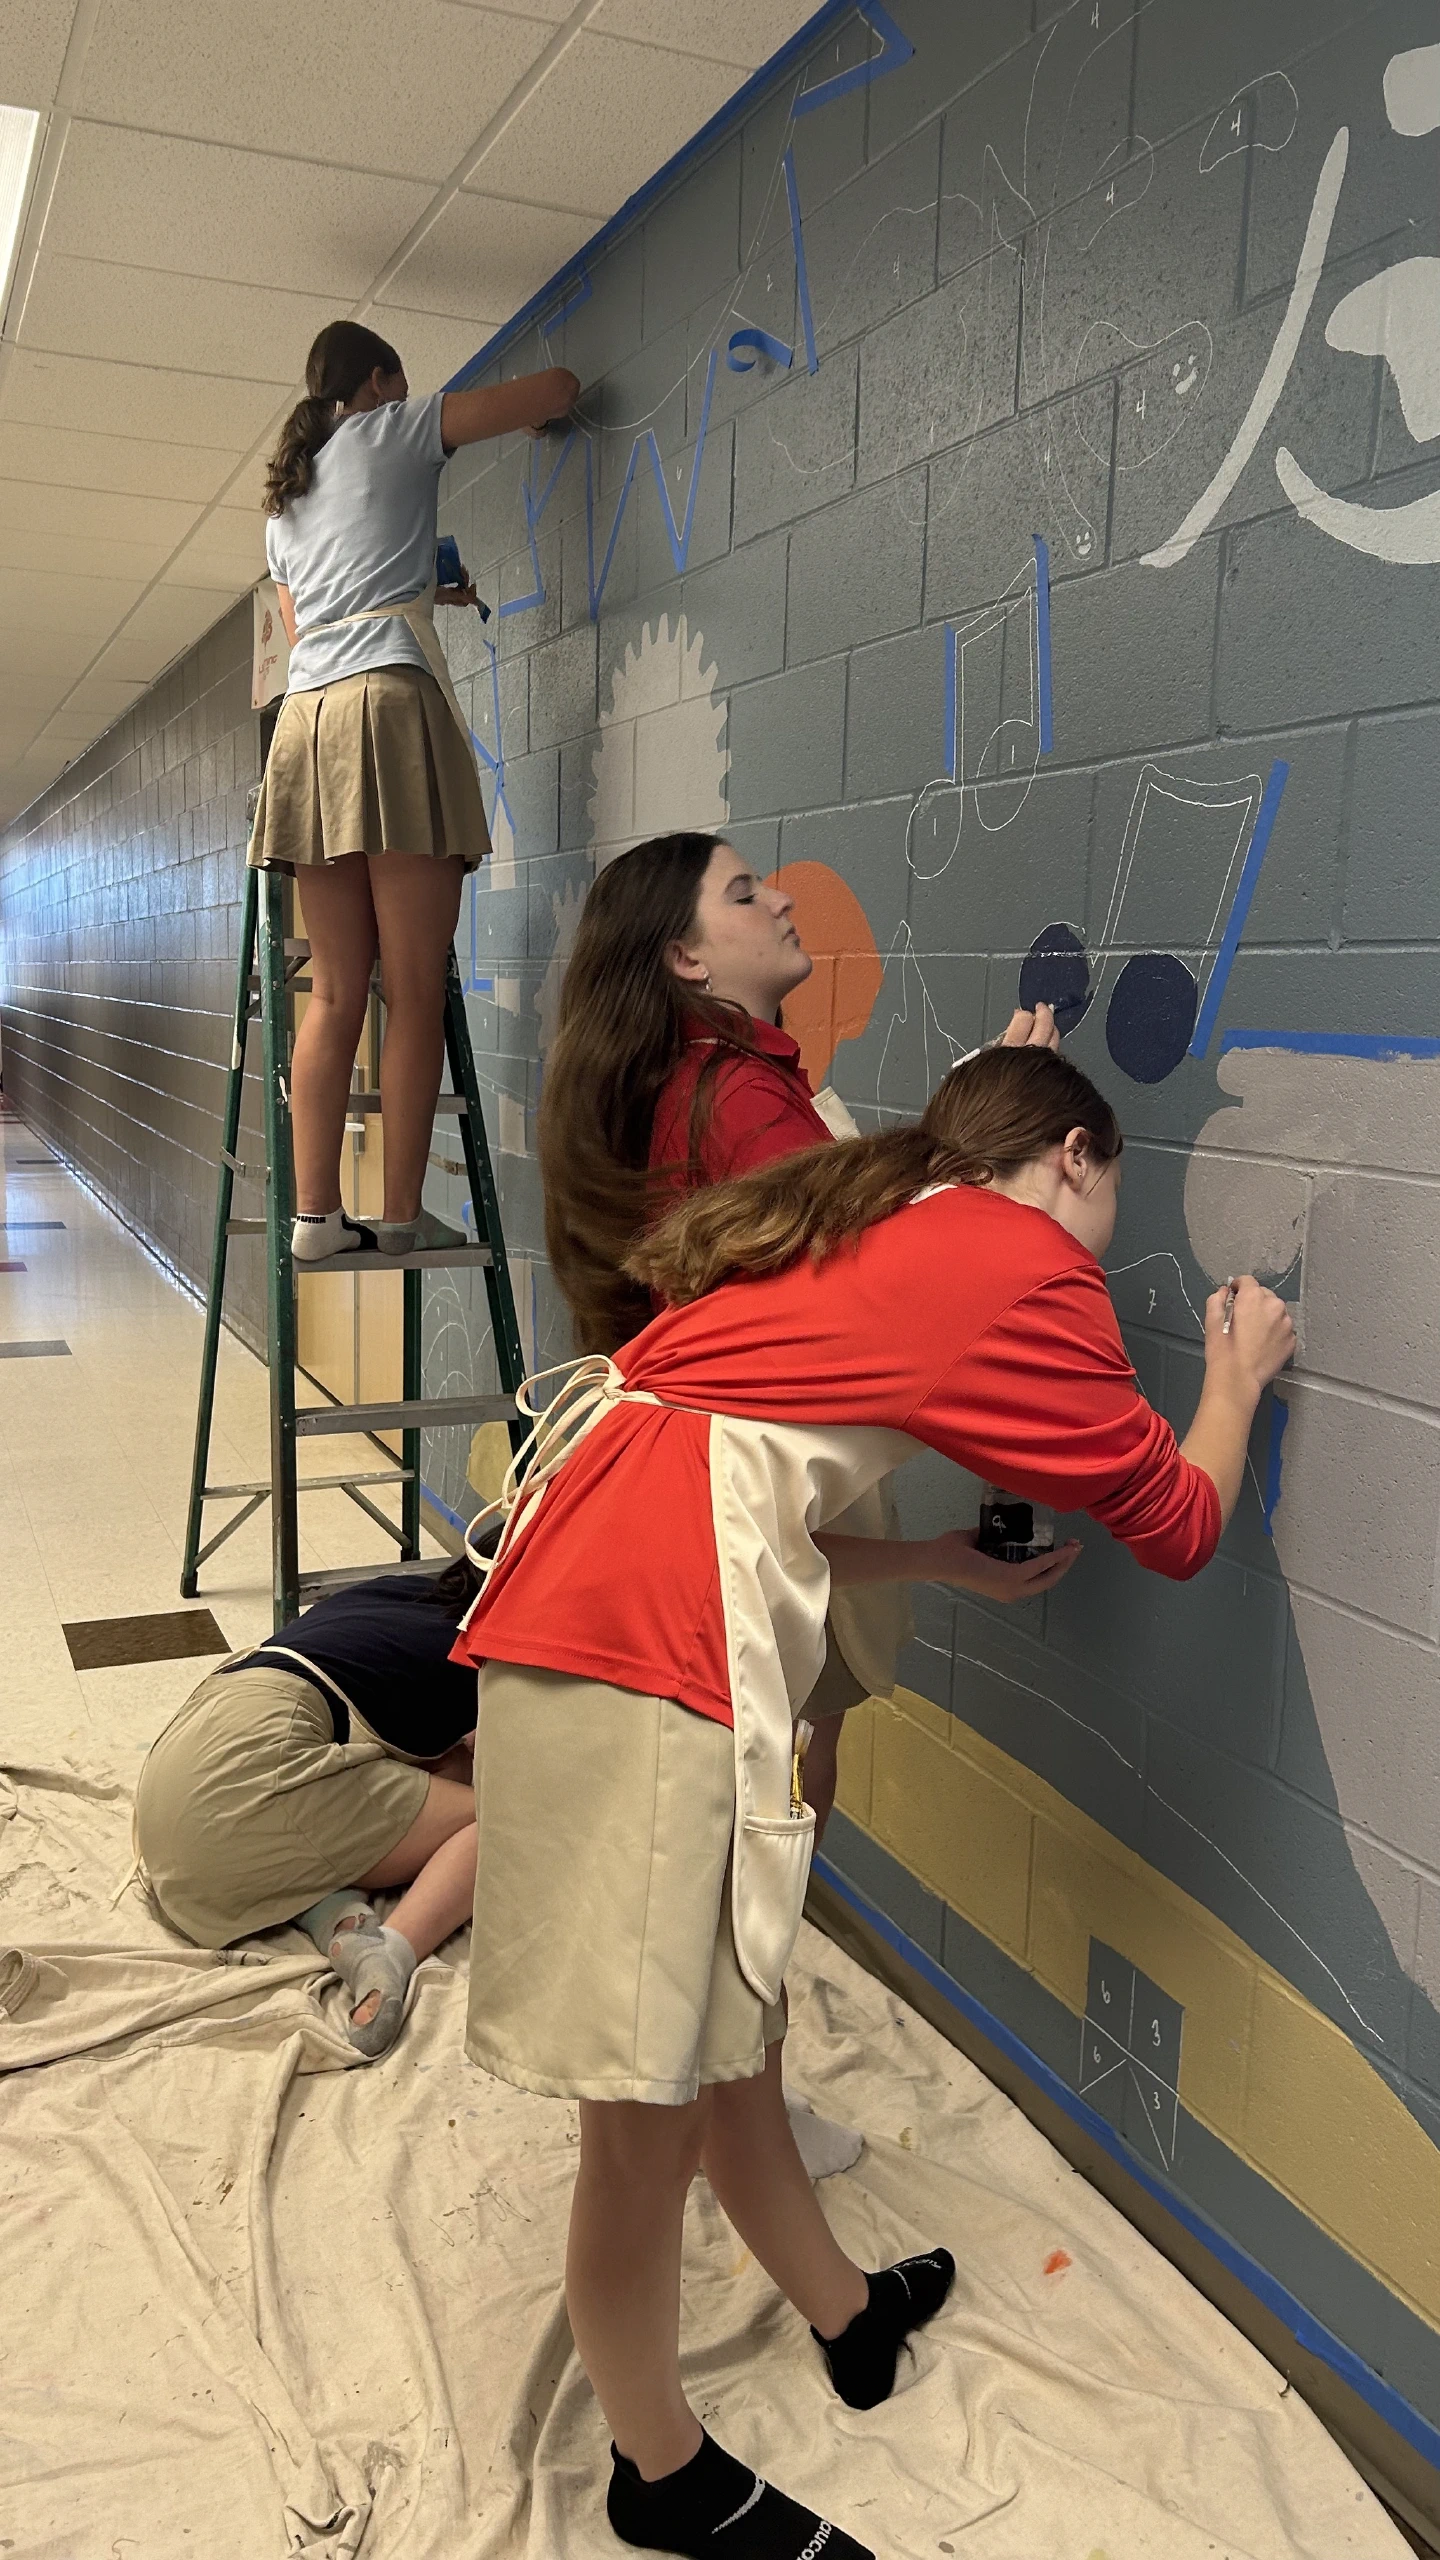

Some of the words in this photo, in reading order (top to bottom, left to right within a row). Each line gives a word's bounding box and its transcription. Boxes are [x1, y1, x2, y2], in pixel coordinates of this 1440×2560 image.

[1090, 1, 1099, 30] 4
[1230, 108, 1241, 138] 4
[1105, 181, 1115, 207] 4
[892, 253, 901, 281] 4
[765, 272, 774, 293] 2
[1135, 389, 1146, 421] 4
[1043, 445, 1052, 473] 4
[1010, 744, 1016, 766] 1
[932, 817, 938, 837] 1
[1147, 1287, 1158, 1315] 7
[1101, 1979, 1112, 2005] 6
[1151, 2018, 1163, 2047] 3
[1092, 2045, 1102, 2064] 6
[1153, 2091, 1162, 2110] 3
